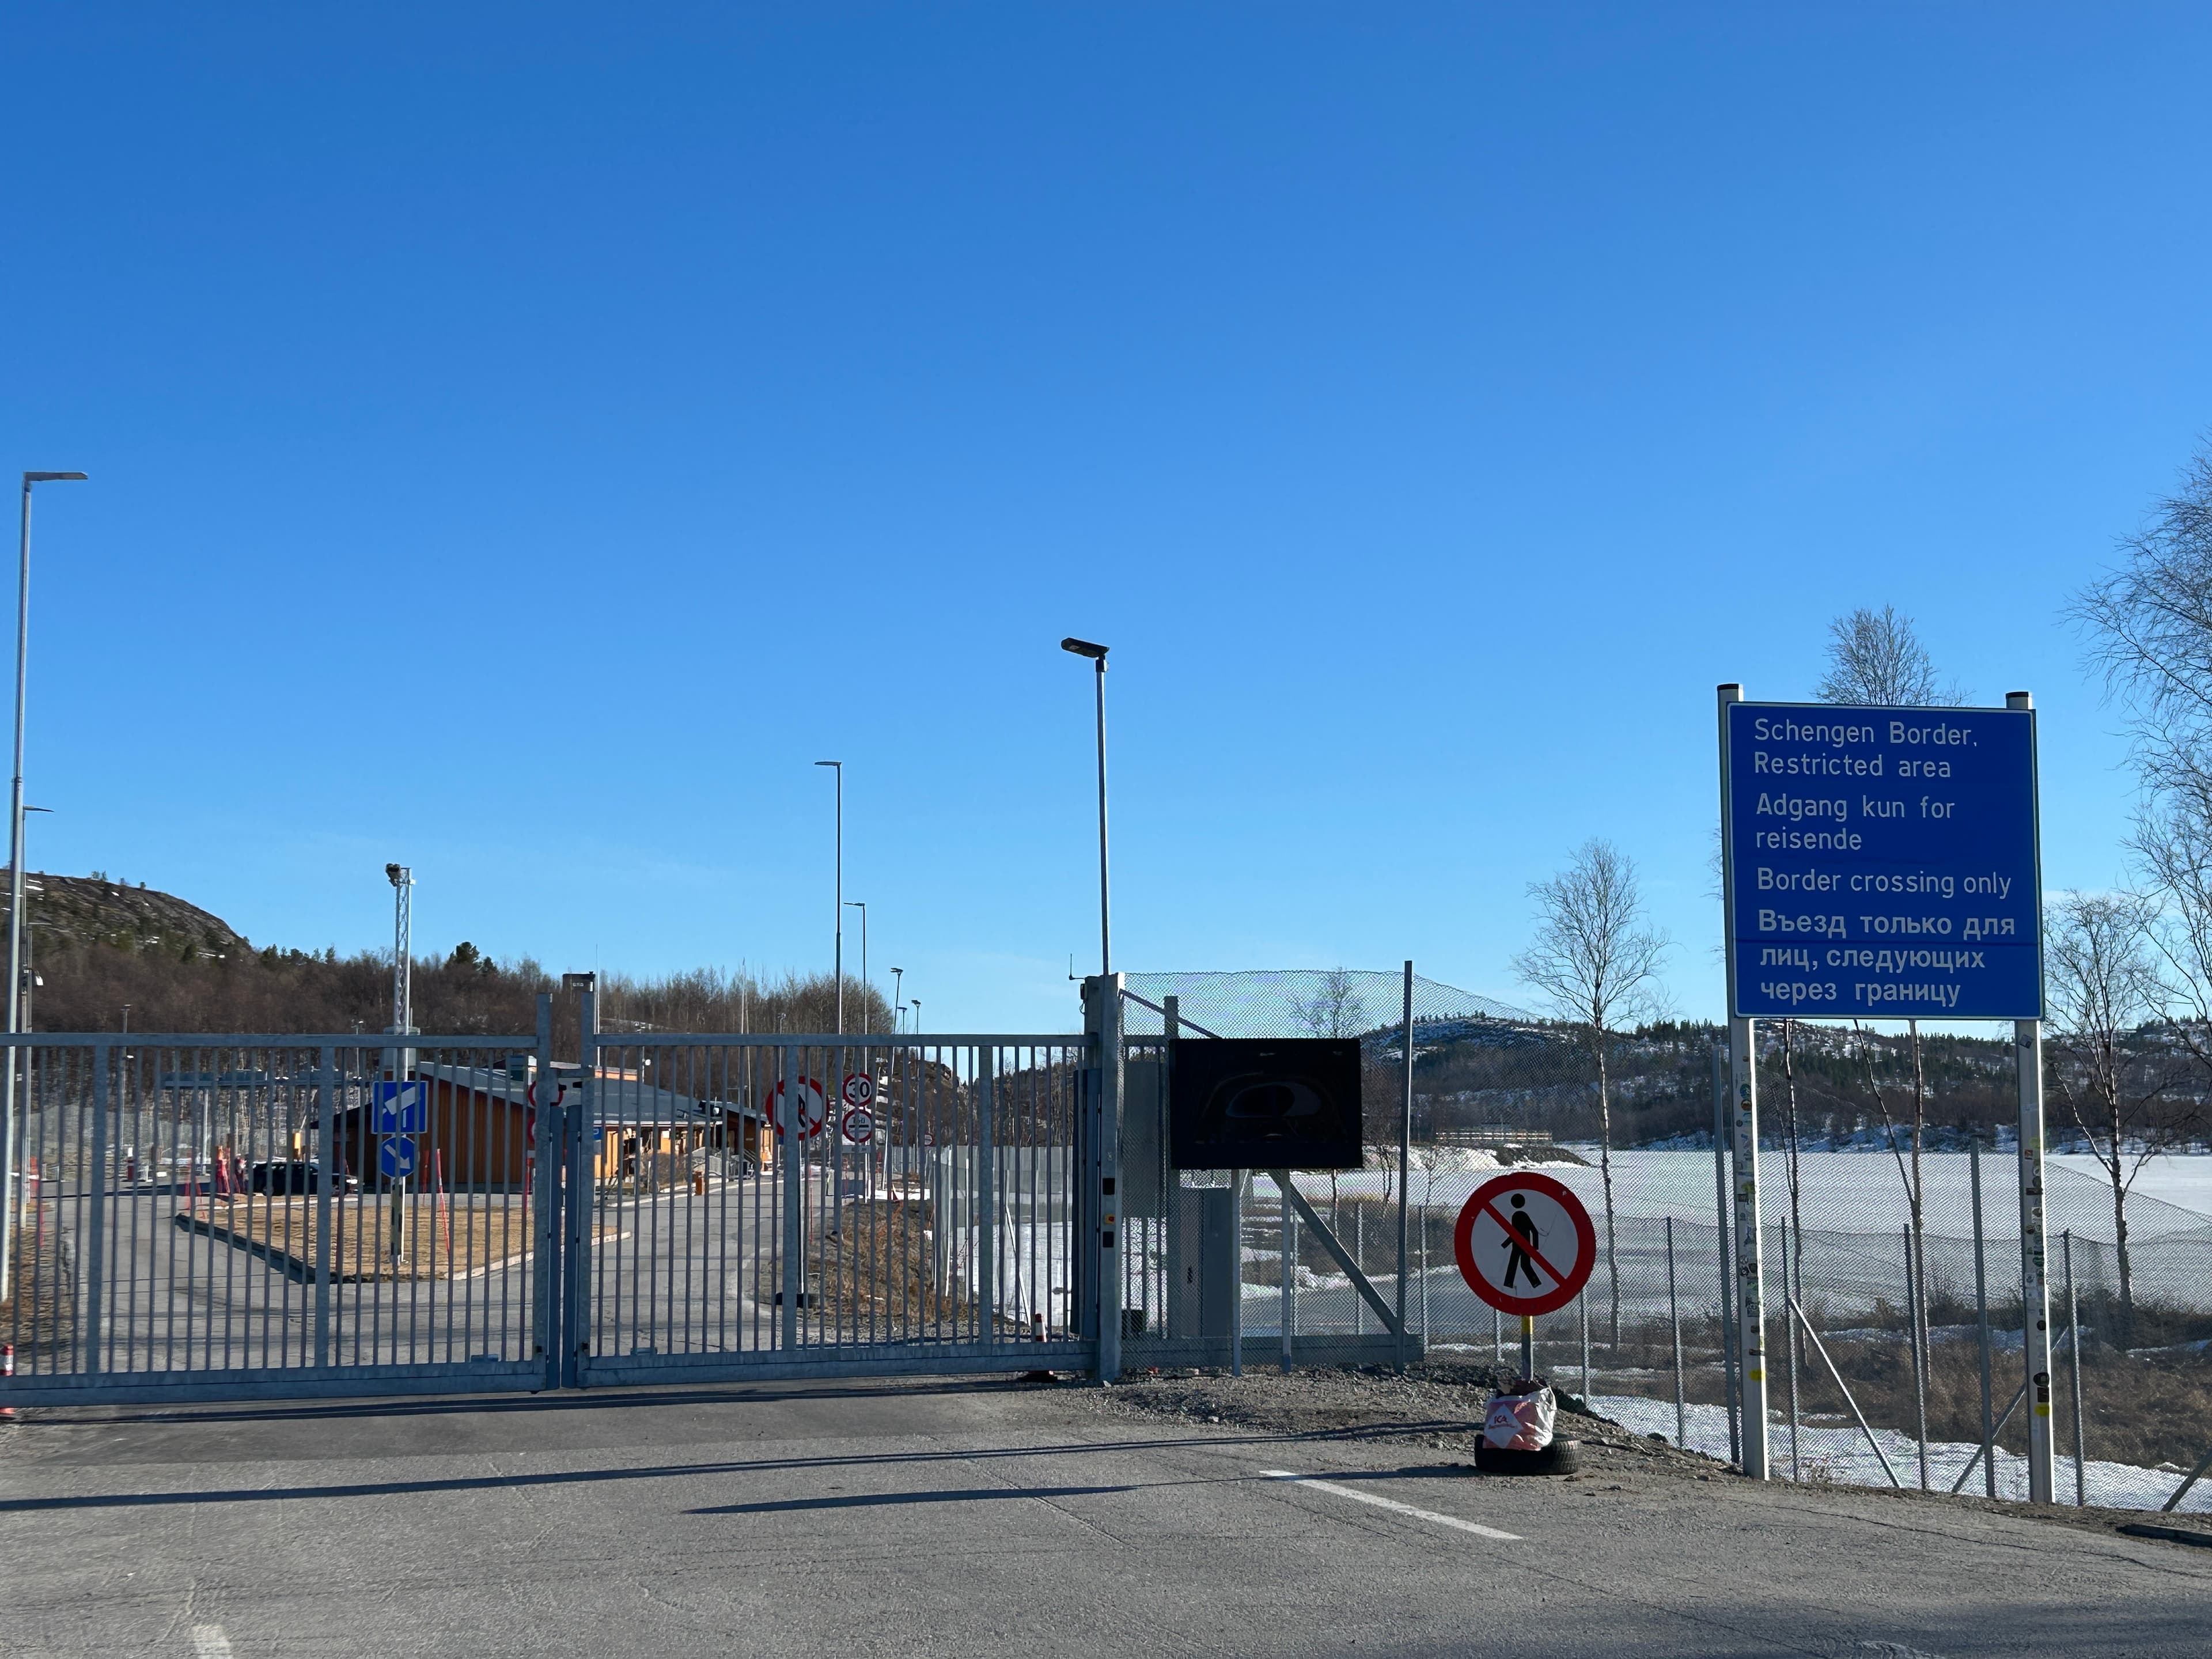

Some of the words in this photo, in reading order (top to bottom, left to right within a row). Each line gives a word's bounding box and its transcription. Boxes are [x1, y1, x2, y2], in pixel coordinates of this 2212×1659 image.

[1755, 718, 1874, 748] Schengen
[1755, 751, 1883, 776] Restricted
[1899, 759, 1950, 778] area
[1756, 793, 1847, 822] Adgang
[1862, 795, 1905, 817] kun
[1920, 796, 1955, 819] for
[1756, 826, 1862, 850] reisende
[1758, 867, 1841, 891] Border
[1850, 870, 1954, 899] crossing
[1964, 872, 2012, 899] only
[1759, 909, 1846, 939] Въезд
[1859, 915, 1952, 934] только
[1963, 918, 2014, 941] для
[1760, 948, 1818, 972] лиц,
[1827, 949, 1985, 974] следующих
[1761, 982, 1837, 1006] через
[1855, 983, 1961, 1007] границу
[1494, 1415, 1508, 1424] ICA
